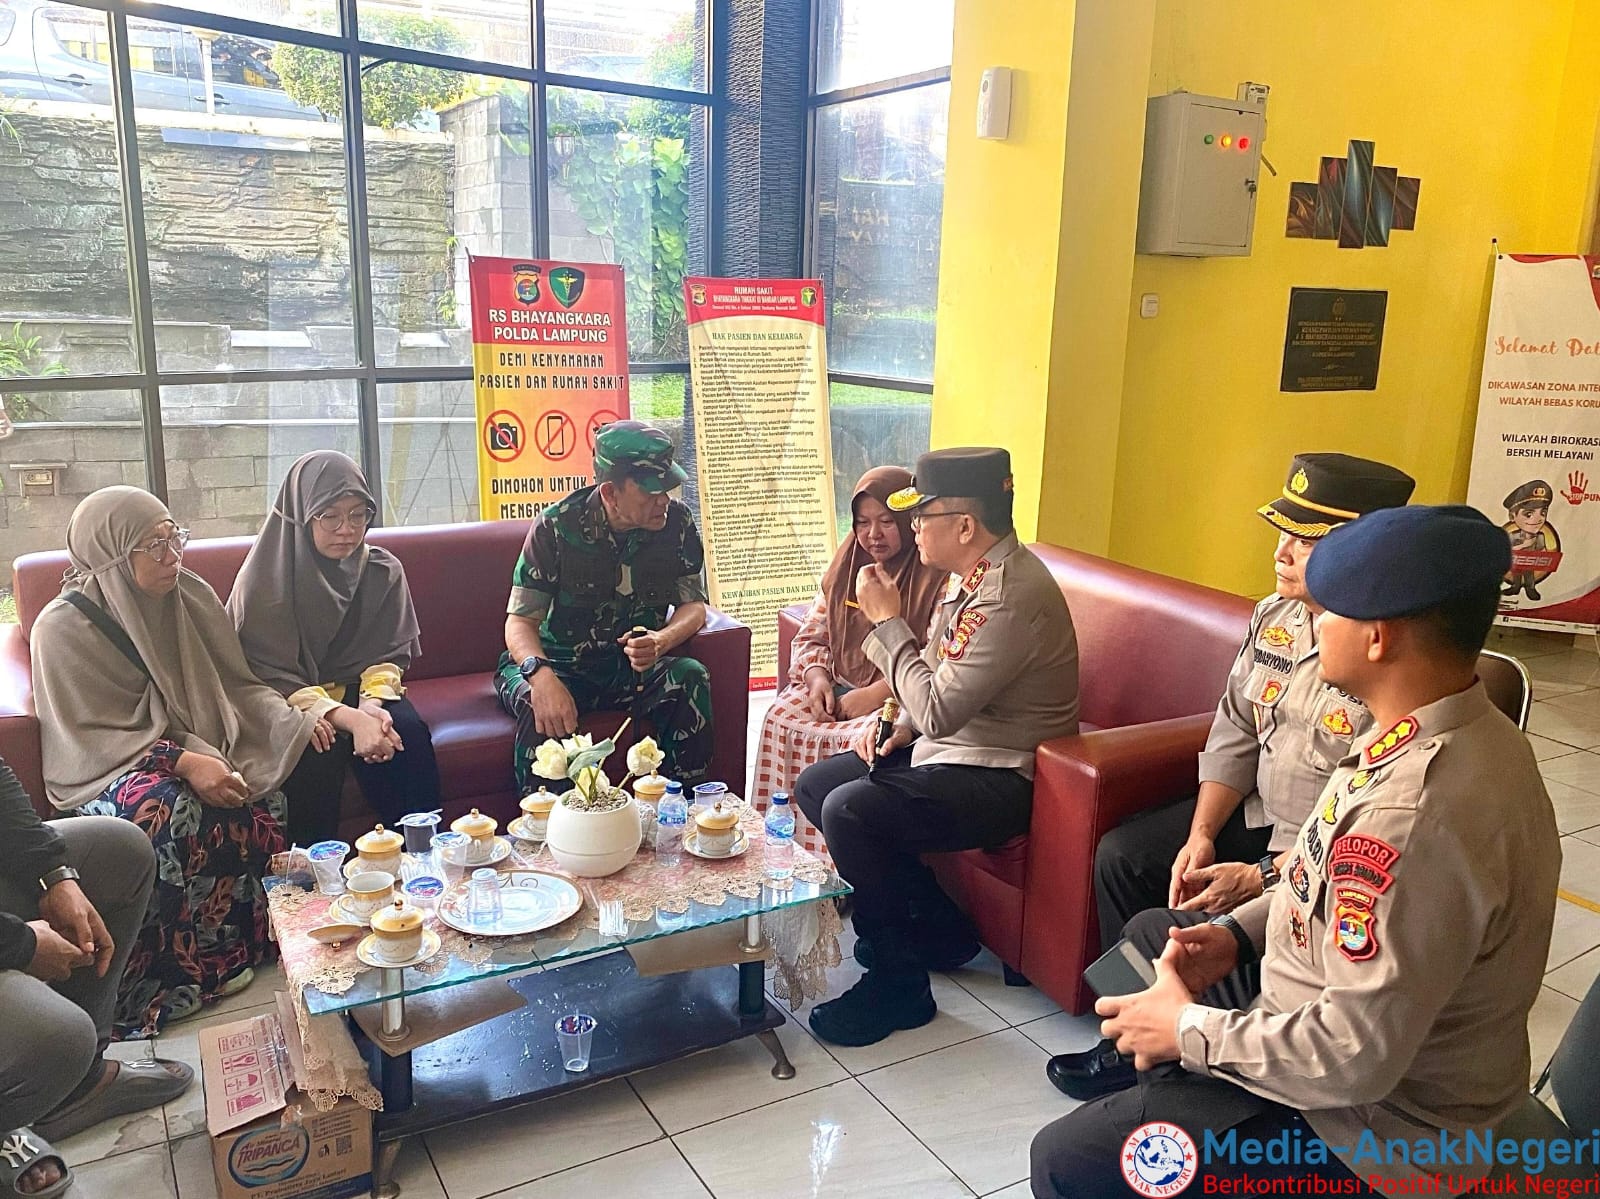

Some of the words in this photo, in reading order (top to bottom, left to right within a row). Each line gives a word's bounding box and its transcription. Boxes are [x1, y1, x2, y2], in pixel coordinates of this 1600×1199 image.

[734, 286, 756, 295] RUMAH
[756, 286, 773, 294] SAKIT
[488, 309, 506, 322] RS
[511, 310, 611, 326] BHAYANGKARA
[494, 327, 539, 340] POLDA
[543, 329, 607, 342] LAMPUNG
[712, 332, 726, 341] HAK
[728, 332, 752, 341] PASIEN
[753, 332, 766, 341] DAN
[768, 332, 803, 340] KELUARGA
[1495, 336, 1559, 356] Selamat
[500, 352, 526, 366] DEMI
[532, 353, 604, 368] KENYAMANAN
[480, 374, 520, 388] PASIEN
[526, 375, 546, 389] DAN
[553, 375, 588, 389] RUMAH
[593, 376, 624, 389] SAKIT
[1488, 381, 1546, 390] DIKAWASAN
[1548, 383, 1576, 391] ZONA
[1579, 384, 1600, 392] INTE
[1500, 397, 1542, 406] WILAYAH
[1544, 398, 1574, 407] BEBAS
[1502, 433, 1548, 443] WILAYAH
[1506, 448, 1541, 458] BERSIH
[1544, 450, 1593, 460] MELAYANI
[492, 477, 544, 494] DIMOHON
[550, 476, 586, 492] UNTUK
[721, 589, 761, 600] KEWAJIBAN
[761, 587, 785, 596] PASIEN
[786, 585, 800, 594] DAN
[1337, 838, 1389, 864] PELOPOR
[237, 1135, 300, 1168] TRIPANCA
